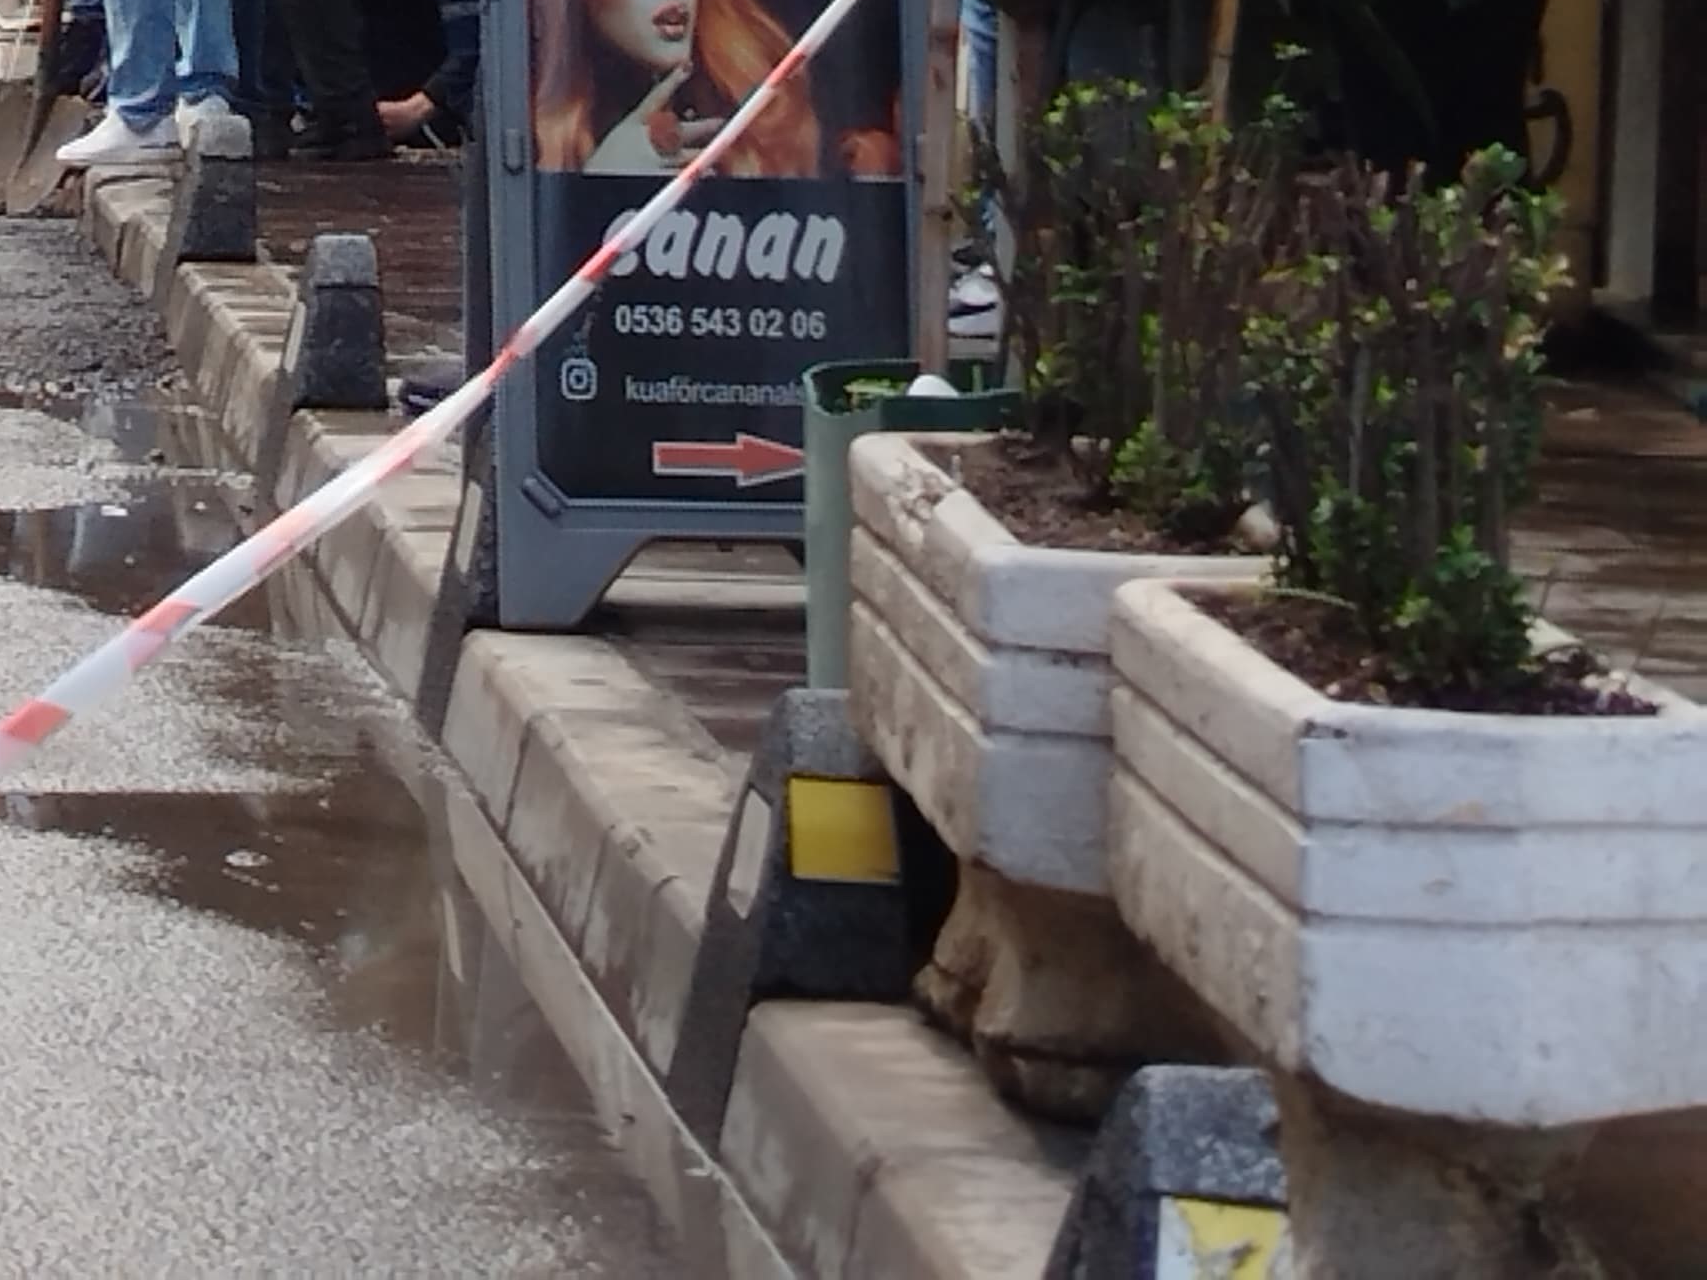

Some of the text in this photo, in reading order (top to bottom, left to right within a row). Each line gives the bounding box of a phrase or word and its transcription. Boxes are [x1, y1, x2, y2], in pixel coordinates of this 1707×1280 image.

[614, 304, 827, 340] 0536 543 02 06
